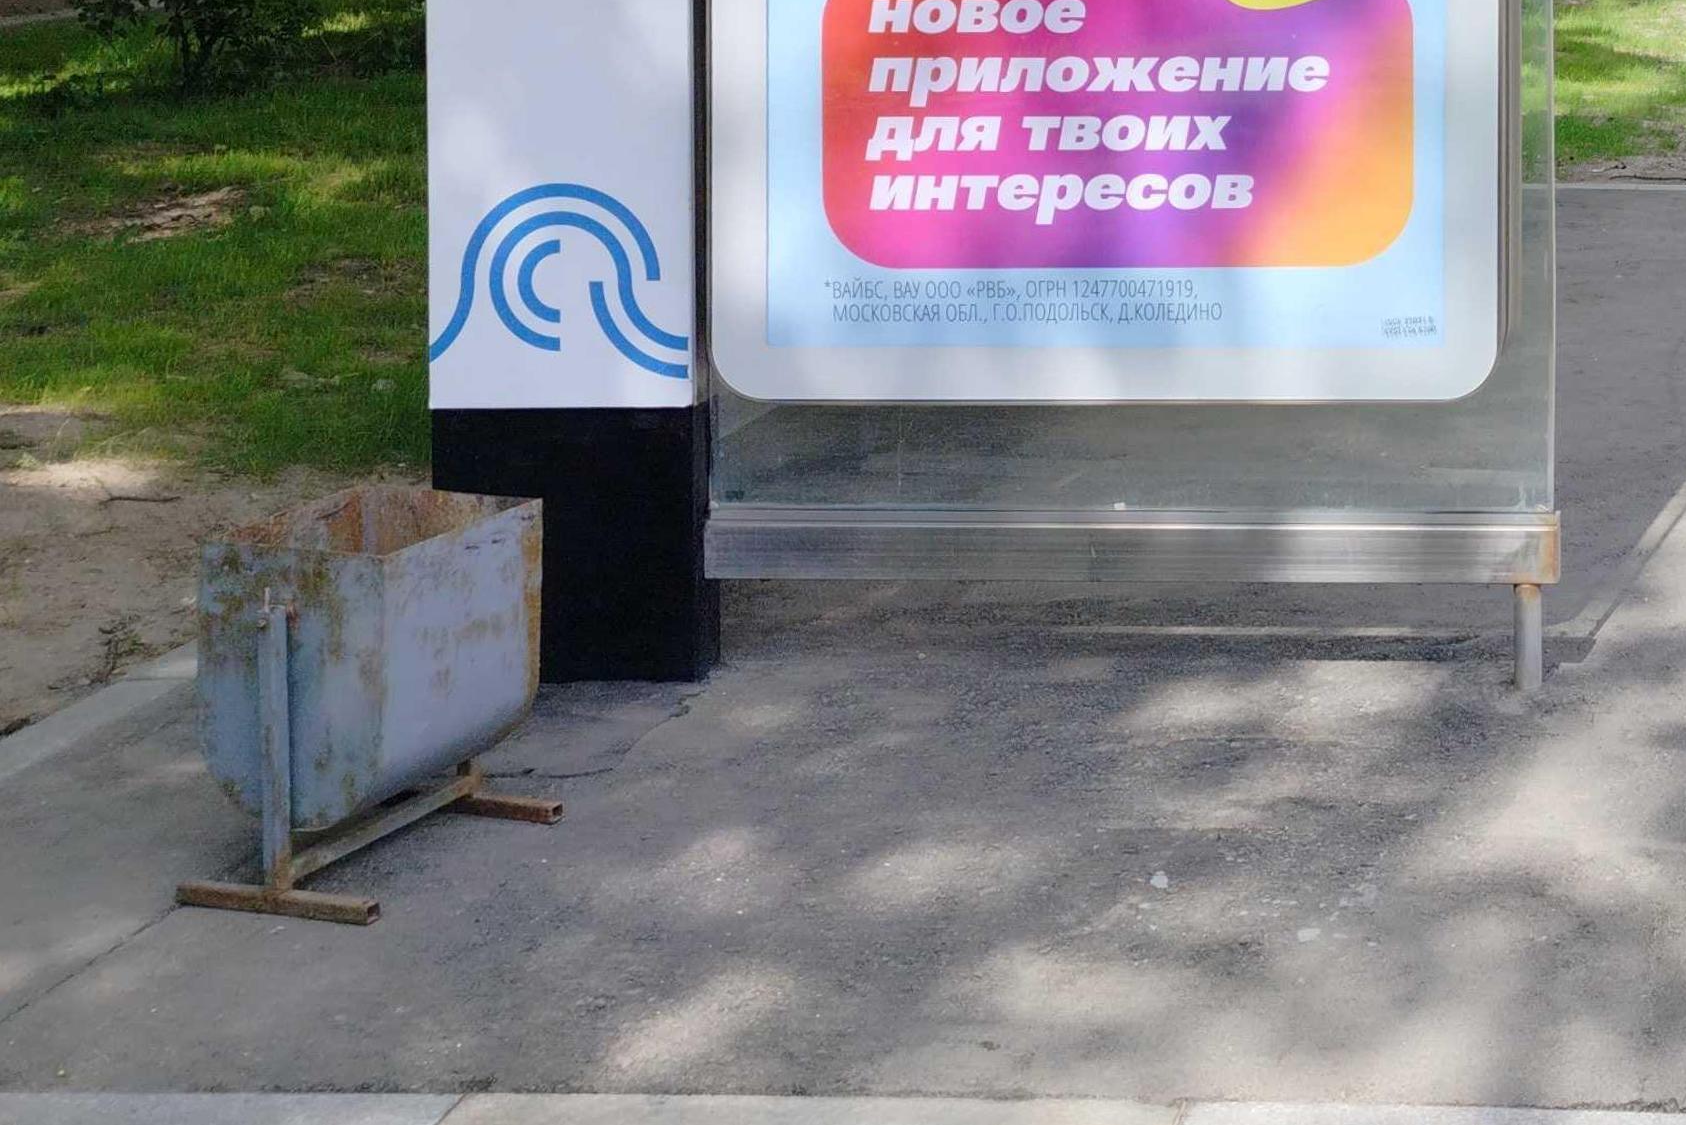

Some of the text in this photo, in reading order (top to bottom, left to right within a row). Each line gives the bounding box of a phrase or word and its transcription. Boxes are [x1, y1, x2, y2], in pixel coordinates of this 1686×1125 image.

[868, 55, 1331, 107] приложение
[865, 115, 1230, 162] для твоих
[868, 172, 1254, 225] интересов
[832, 303, 940, 323] МОСКОВСКАЯ
[945, 303, 988, 324] ОБЛ.,
[1117, 302, 1223, 325] Д.КОЛЕДИНО
[893, 280, 921, 300] ВАУ
[925, 280, 962, 299] ООО
[967, 280, 1021, 301] «РВБ»,
[1025, 279, 1066, 299] ОГРН
[1071, 279, 1199, 300] 1247700471919,
